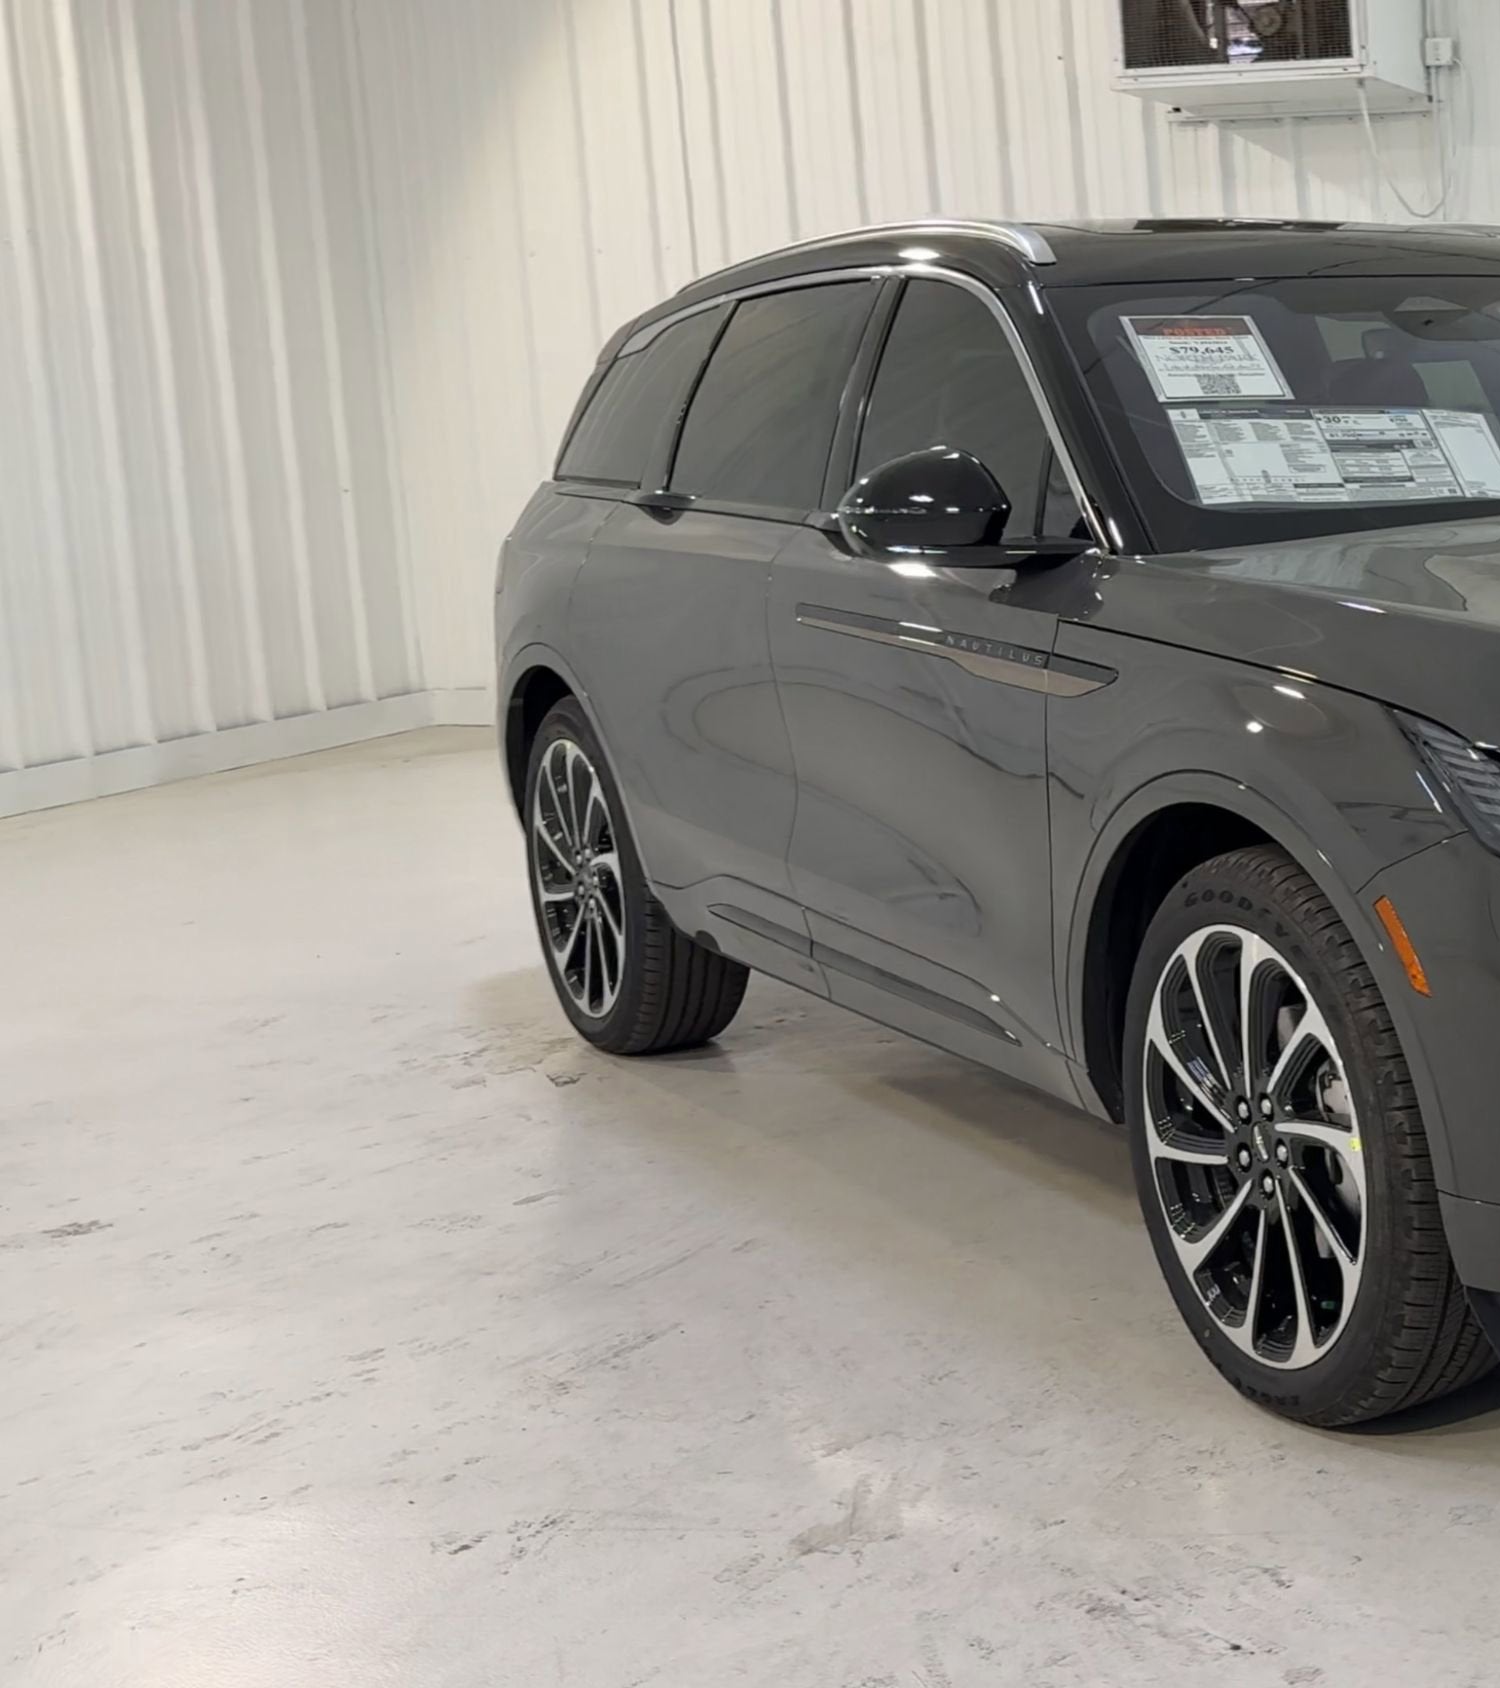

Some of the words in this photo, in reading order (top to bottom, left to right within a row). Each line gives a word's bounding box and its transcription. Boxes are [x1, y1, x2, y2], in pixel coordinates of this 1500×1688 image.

[1169, 346, 1235, 355] $79,645
[1322, 415, 1342, 424] 30
[946, 635, 1043, 665] NAUTILUS
